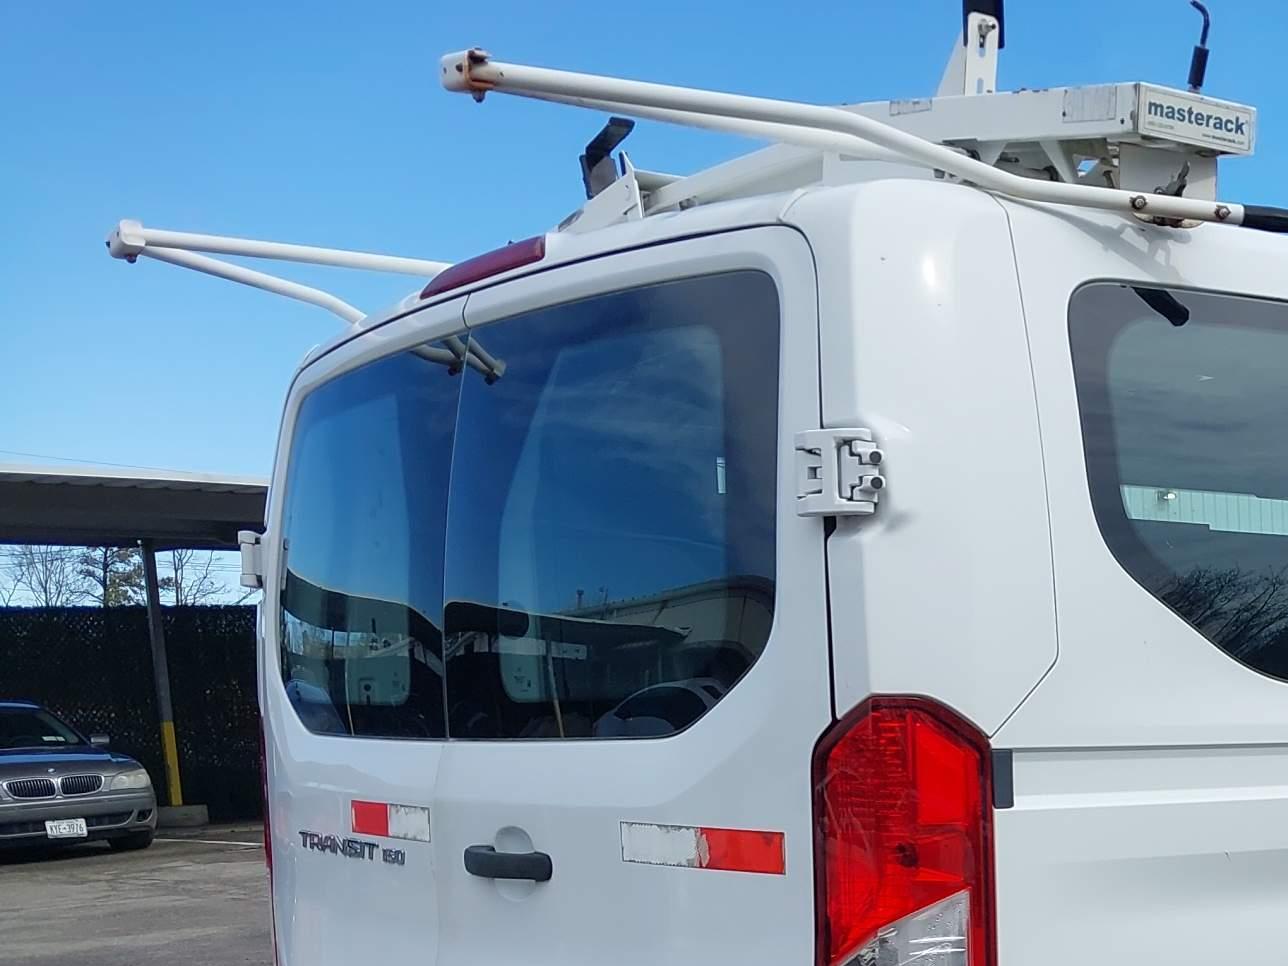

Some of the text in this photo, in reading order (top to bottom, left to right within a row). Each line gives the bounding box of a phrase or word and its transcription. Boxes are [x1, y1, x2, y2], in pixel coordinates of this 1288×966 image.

[1148, 100, 1245, 135] masterack
[299, 831, 405, 865] TRANSIT 150
